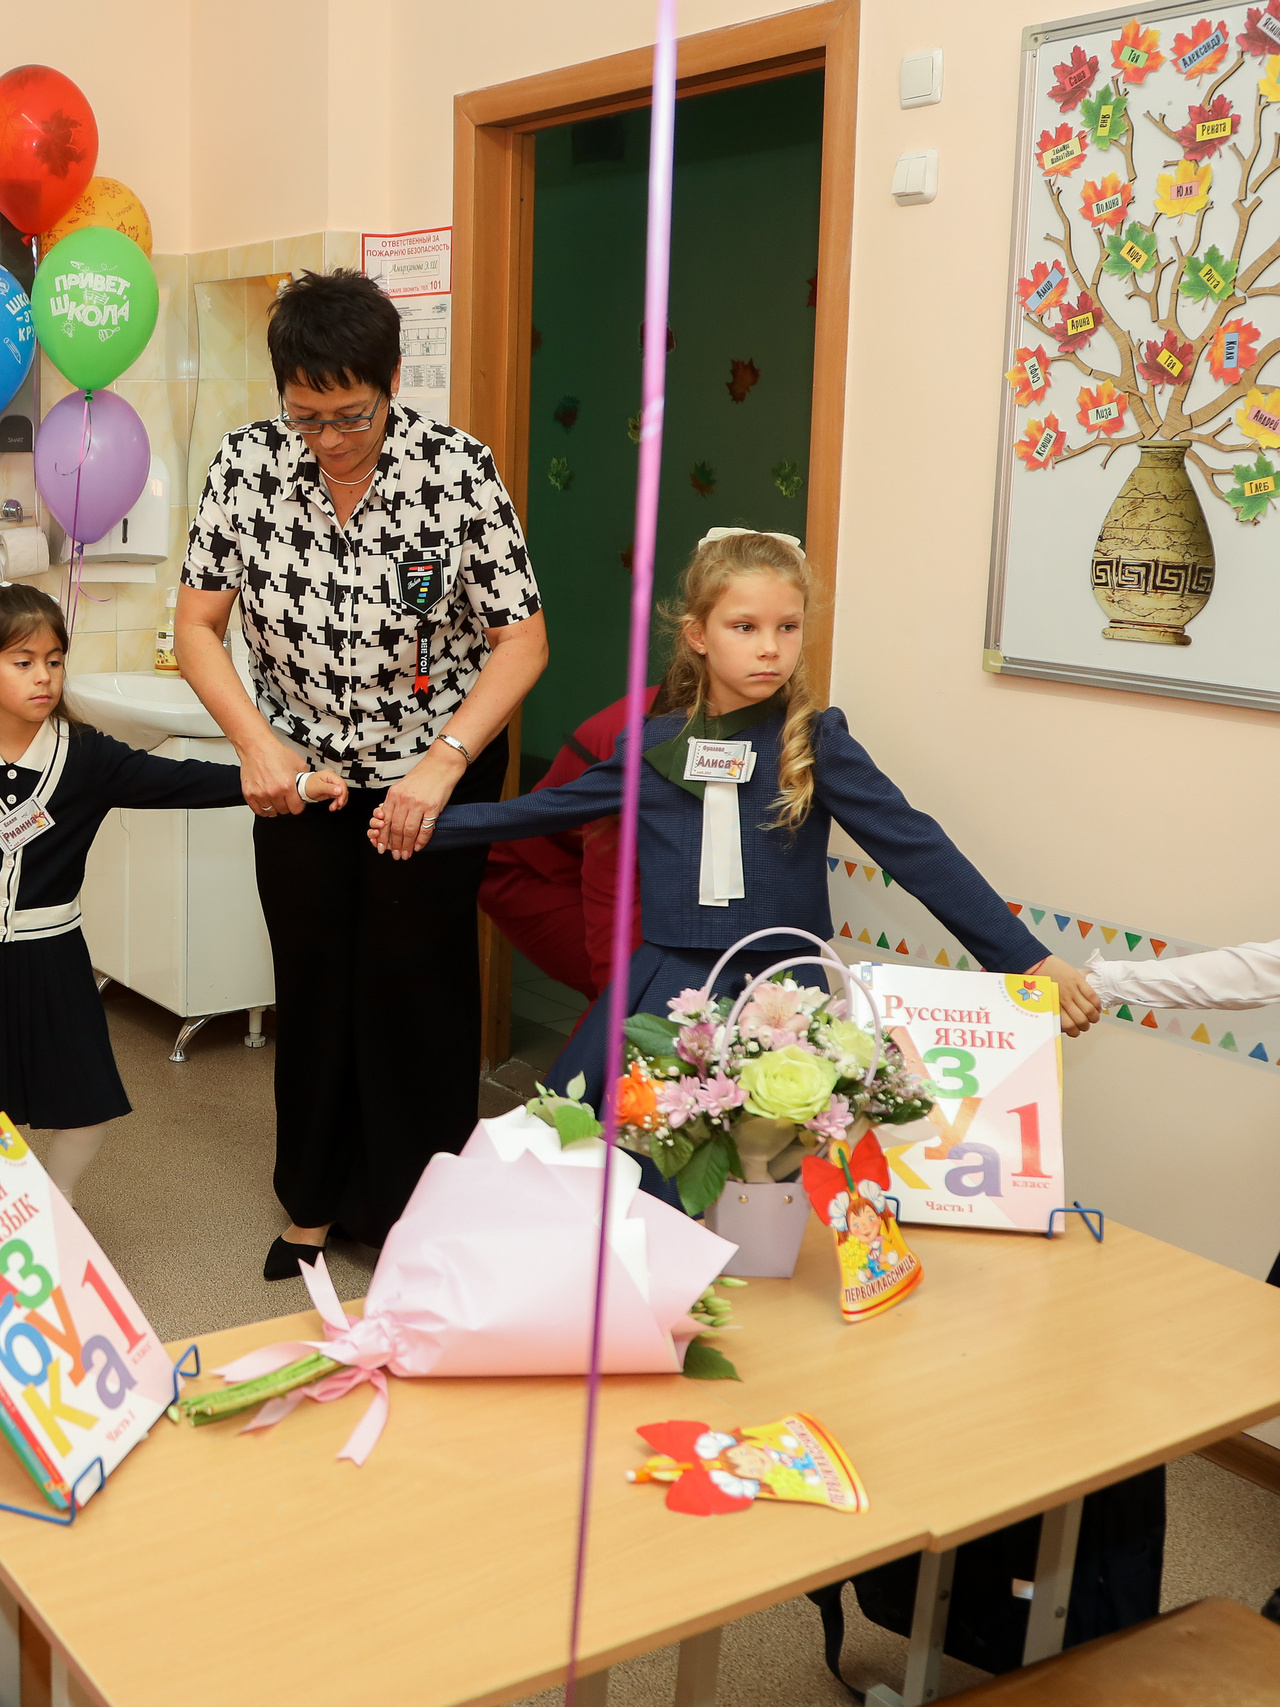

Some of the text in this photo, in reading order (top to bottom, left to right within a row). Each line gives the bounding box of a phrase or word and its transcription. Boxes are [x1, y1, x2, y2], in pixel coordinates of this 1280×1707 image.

[1127, 49, 1140, 64] Тая
[1181, 34, 1221, 68] Александр
[1068, 70, 1086, 87] Саша
[1099, 113, 1111, 128] Яна
[1201, 122, 1226, 136] Рената
[1176, 185, 1193, 198] Юля
[1095, 196, 1120, 214] Полина
[366, 243, 450, 257] ПОЖАРНУЮ БЕЗОПАСНОСТЬ
[381, 235, 440, 248] ОТВЕТСТВЕННЫЙ ЗА
[1126, 245, 1143, 263] Кира
[54, 272, 131, 300] ПРИВЕТ,
[430, 280, 441, 290] 101
[1204, 268, 1220, 289] Рита
[1036, 280, 1053, 299] Амир
[49, 293, 130, 327] ШКОЛА
[1071, 318, 1090, 331] Арина
[1225, 340, 1237, 360] Коля
[1163, 354, 1176, 371] Тая
[1095, 407, 1112, 420] Лиза
[1253, 409, 1280, 431] Андрей
[1035, 432, 1053, 457] Ксюша
[420, 656, 428, 674] YOU
[697, 755, 731, 769] Алиса
[881, 994, 992, 1026] Русский
[1006, 1102, 1053, 1179] 1
[1011, 1179, 1050, 1190] класс
[926, 1201, 975, 1213] Часть 1
[844, 1253, 918, 1304] ПЕРВОКЛАССНИЦА
[81, 1259, 147, 1355] 1
